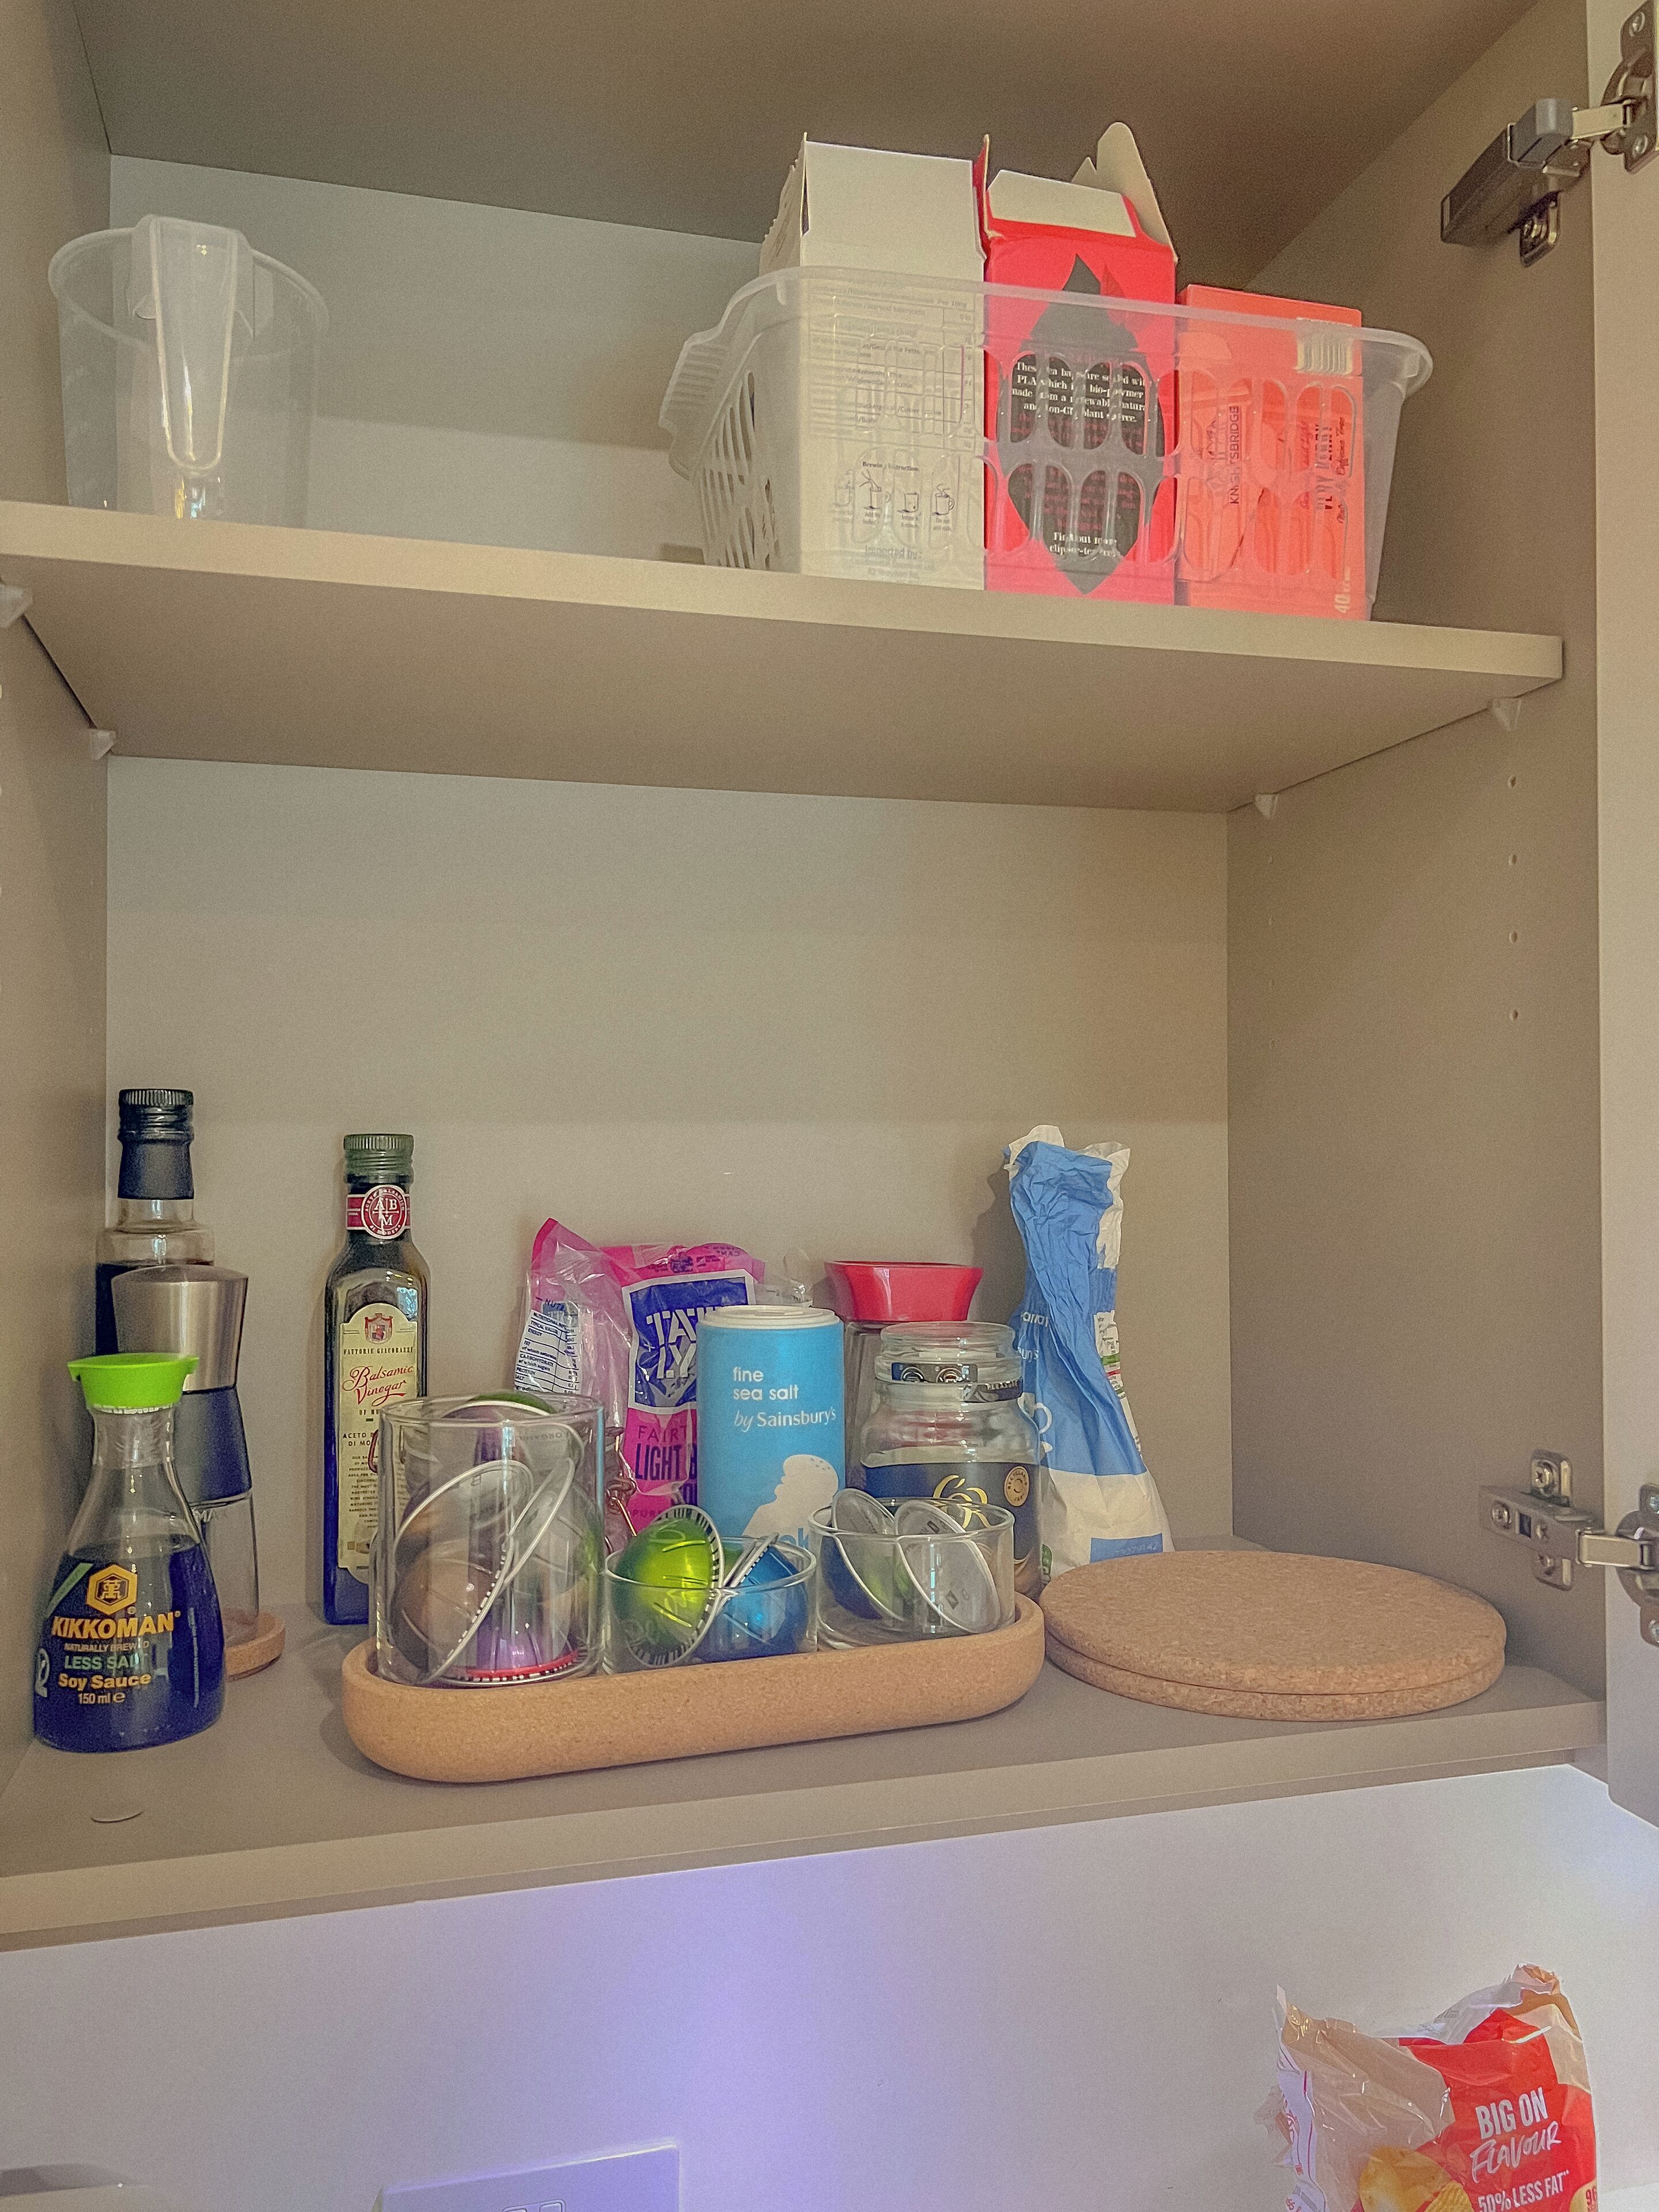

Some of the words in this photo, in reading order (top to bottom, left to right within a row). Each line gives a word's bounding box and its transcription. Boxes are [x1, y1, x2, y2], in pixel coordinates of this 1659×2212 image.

[1017, 361, 1037, 372] Thes
[1017, 374, 1036, 384] PLA
[1012, 388, 1033, 397] made
[1024, 403, 1037, 411] an
[863, 461, 888, 469] Brewin
[389, 1199, 397, 1210] B
[342, 1365, 414, 1391] Balsamic
[733, 1366, 764, 1382] fine
[355, 1379, 407, 1407] Vinegar
[733, 1388, 763, 1400] sea
[768, 1384, 800, 1400] salt
[733, 1410, 754, 1433] by
[756, 1406, 836, 1427] Sainsbury's
[638, 1425, 687, 1442] FAIRT
[635, 1443, 683, 1480] LIGHT
[51, 1612, 174, 1639] KIKKOMAN
[64, 1642, 109, 1653] NATURALLY
[109, 1640, 150, 1652] BREWD
[64, 1655, 103, 1670] LESS
[107, 1653, 147, 1669] SAL
[59, 1673, 88, 1691] Soy
[90, 1673, 152, 1690] Sauce
[78, 1692, 96, 1705] 150
[97, 1692, 111, 1703] ml
[1475, 2099, 1517, 2139] BIG
[1518, 2086, 1548, 2127] ON
[1469, 2120, 1562, 2184] FLAVOUR
[1478, 2190, 1512, 2212] 50%
[1512, 2180, 1543, 2208] LESS
